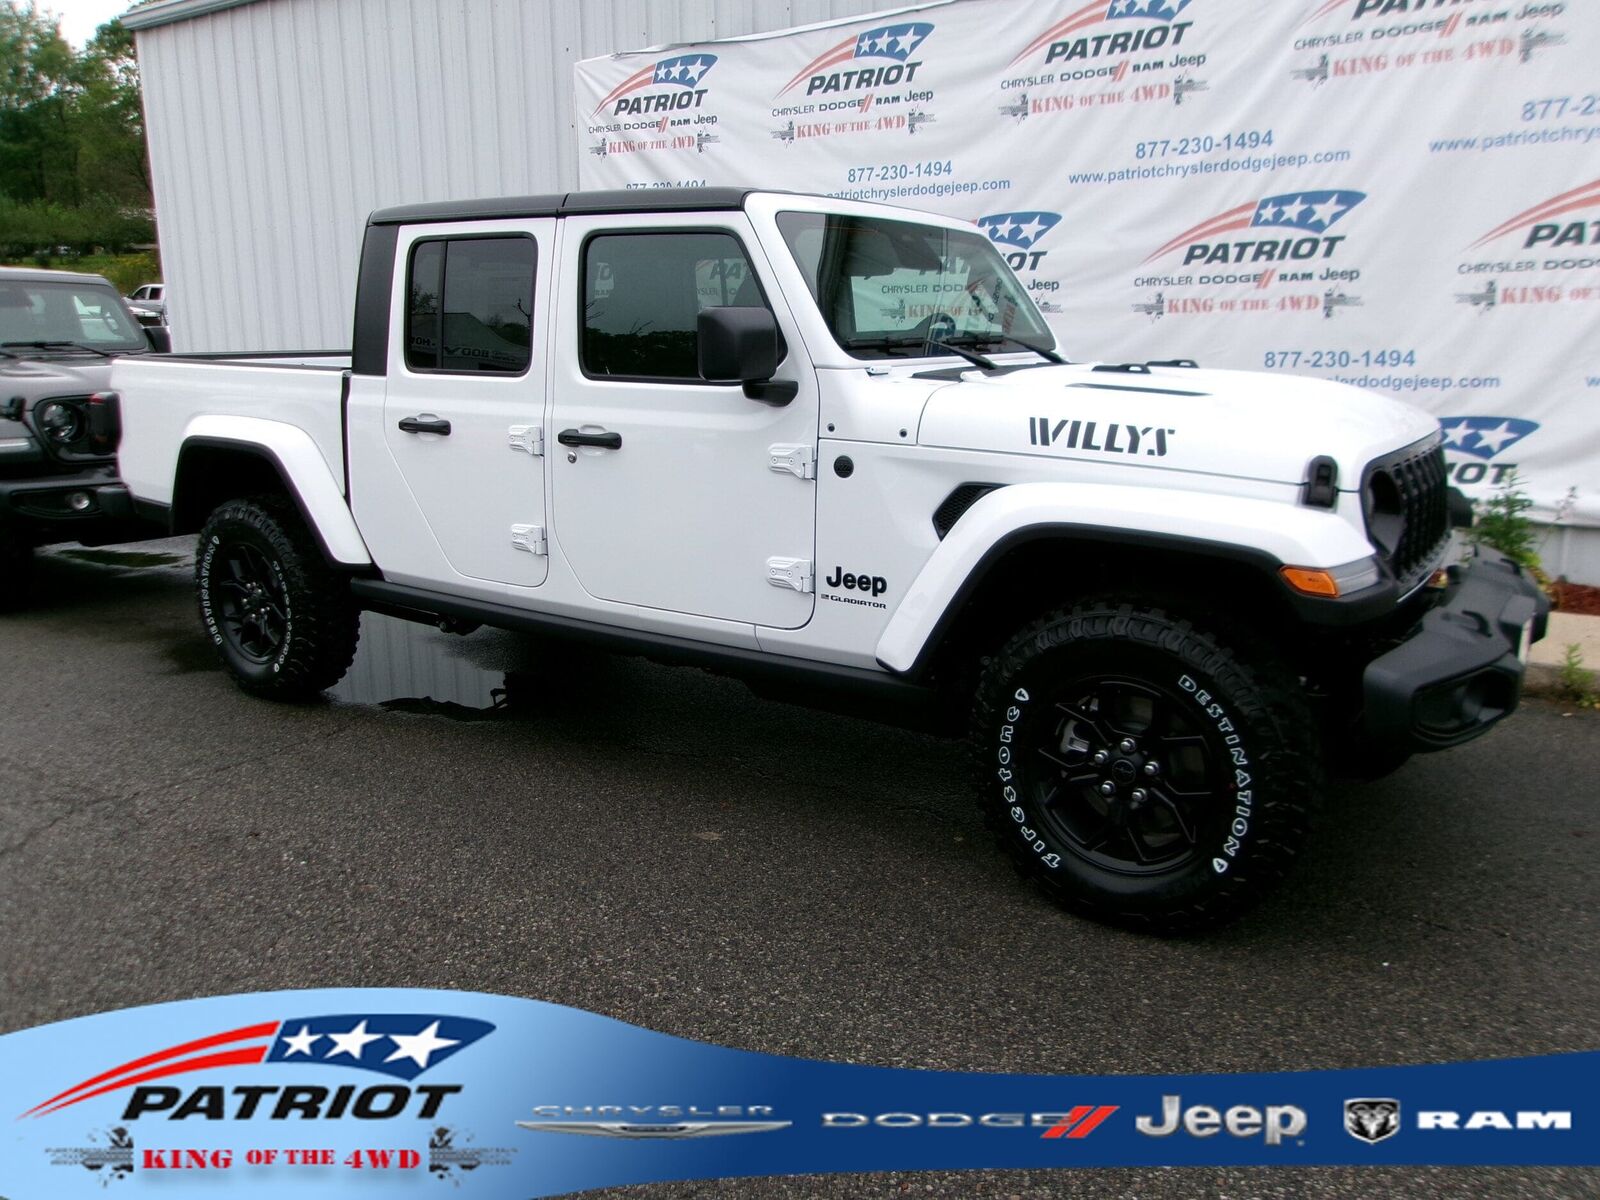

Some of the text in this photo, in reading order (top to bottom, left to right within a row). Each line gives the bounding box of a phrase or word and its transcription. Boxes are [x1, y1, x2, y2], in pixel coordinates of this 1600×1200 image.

[1294, 3, 1565, 50] CHRYSLER DODGE RAM Jeep
[1044, 20, 1194, 65] PATRIOT
[1333, 38, 1515, 77] KING OF THE 4WD
[806, 60, 923, 96] PATRIOT
[1000, 53, 1206, 90] CHRYSLER DODGE RAM Jeep
[614, 89, 708, 116] PATRIOT
[772, 89, 934, 117] CHRYSLER DODGE RAM Jeep
[1032, 83, 1170, 114] KING OF THE 4WD
[1521, 95, 1600, 122] 877-2
[588, 114, 718, 134] CHRYSLER DODGE RAM Jeep
[797, 115, 906, 138] KING OF THE 4WD
[608, 135, 695, 154] KING OF THE 4WD
[1136, 129, 1274, 160] 877-230-1494
[847, 160, 952, 183] 877-230-1494
[1069, 149, 1351, 185] www.patriotchryslerdodgejeep.com
[1001, 250, 1048, 271] OT
[1182, 235, 1346, 266] PATRIOT
[1134, 267, 1360, 288] CHRYSLER DODGE RAM Jeep
[1458, 257, 1600, 275] CHRYSLER DOD
[881, 284, 928, 295] CHRYSLER
[1028, 279, 1060, 293] Jeep
[1501, 286, 1592, 304] KING OF
[1167, 294, 1321, 314] KING OF THE 4WD
[1264, 349, 1416, 369] 877-230-1494
[1029, 416, 1176, 458] WILLYS
[826, 566, 887, 598] Jeep
[831, 594, 887, 610] GLADIATOR
[1178, 674, 1252, 857] DESTINATION
[998, 706, 1061, 869] Firestone
